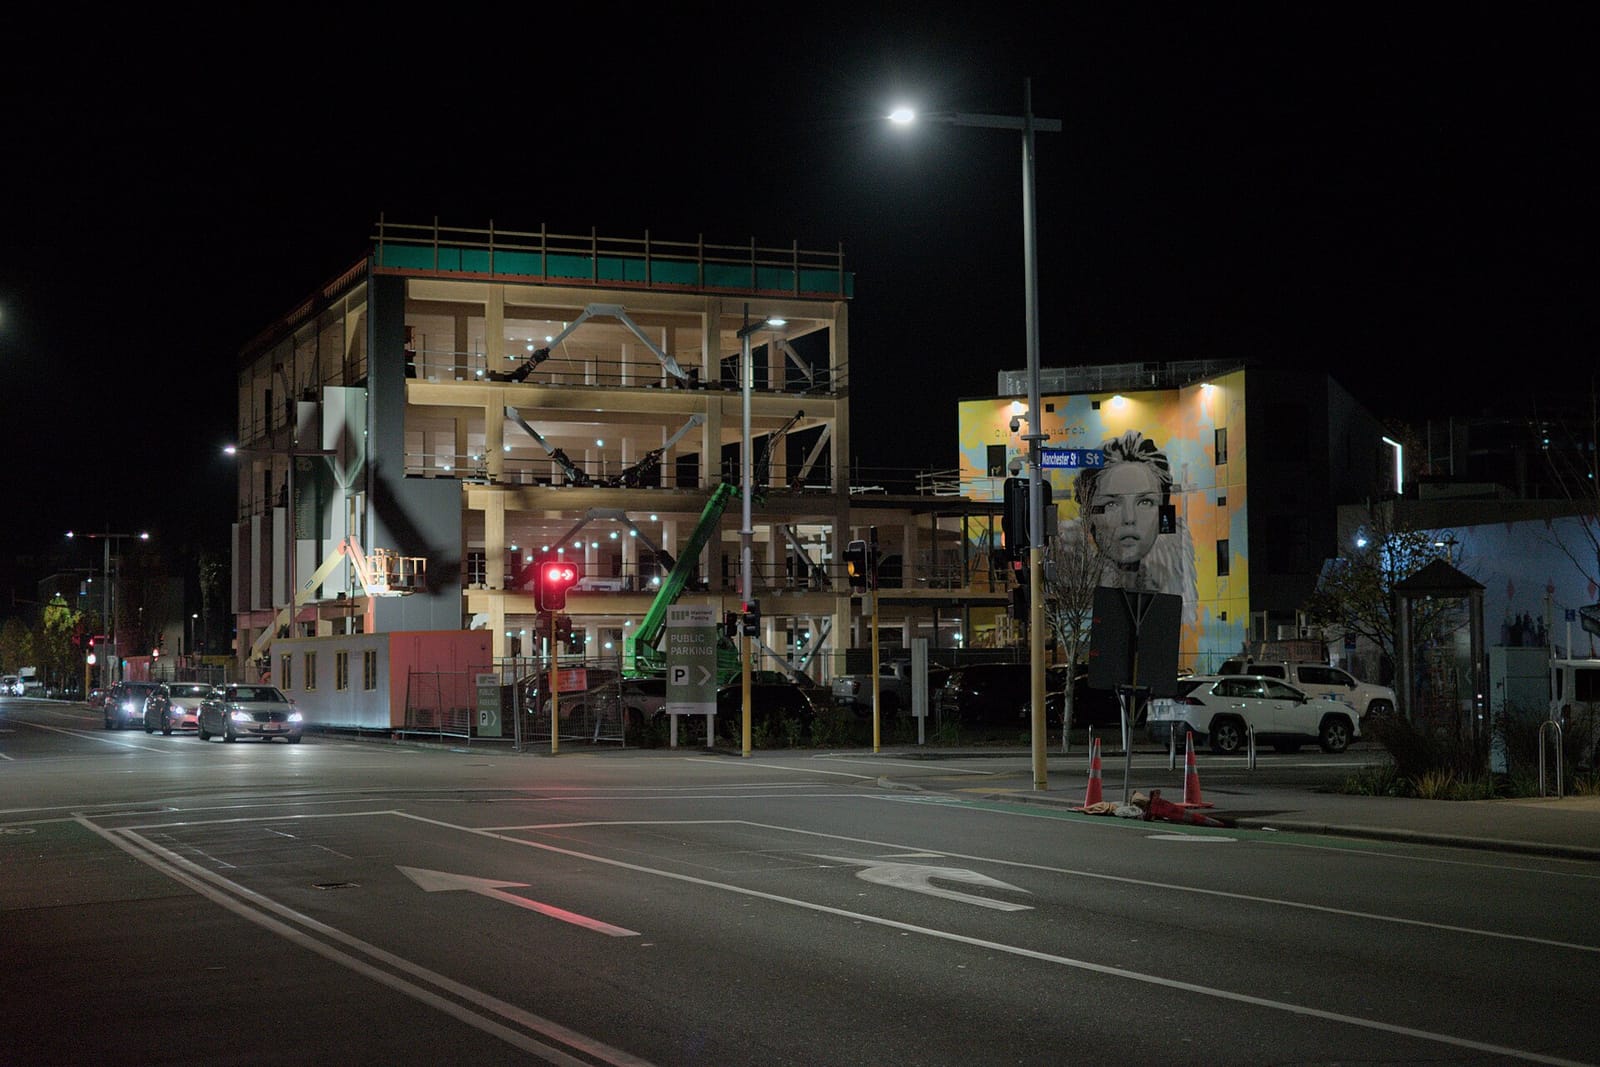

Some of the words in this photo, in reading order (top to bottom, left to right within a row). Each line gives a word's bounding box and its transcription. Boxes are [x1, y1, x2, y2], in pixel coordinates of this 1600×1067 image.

[1042, 451, 1069, 465] Manchester
[1070, 452, 1077, 466] St
[1085, 452, 1100, 465] St
[671, 634, 705, 642] PUBLIC
[671, 647, 713, 655] PARKING
[675, 669, 686, 682] P
